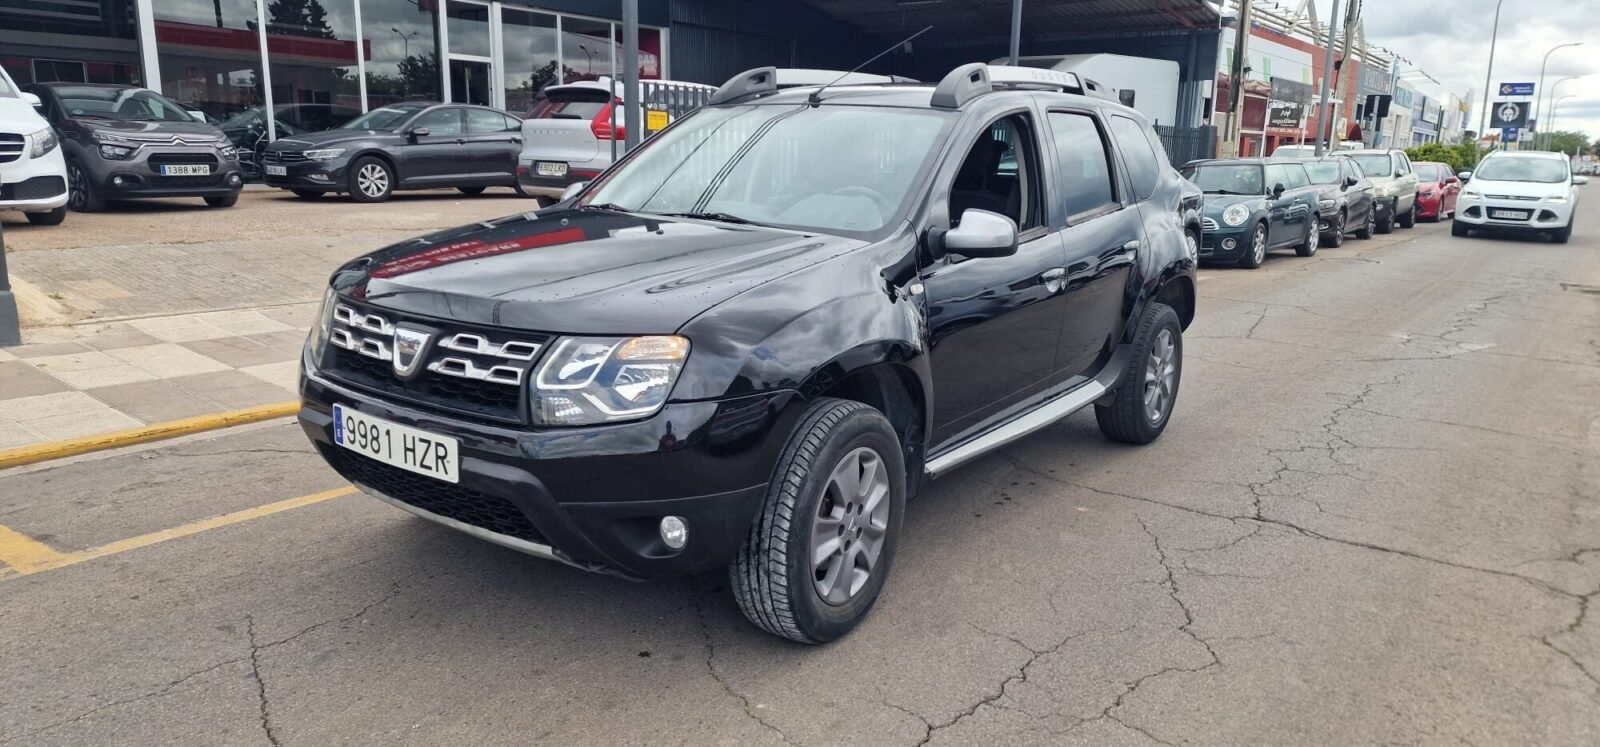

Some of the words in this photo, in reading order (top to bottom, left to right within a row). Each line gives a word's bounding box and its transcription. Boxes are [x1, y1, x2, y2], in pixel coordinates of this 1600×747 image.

[1032, 71, 1075, 83] DUSTER
[167, 166, 189, 175] 1388
[191, 166, 208, 174] MPG
[346, 416, 392, 459] 9981
[403, 433, 449, 476] HZR
